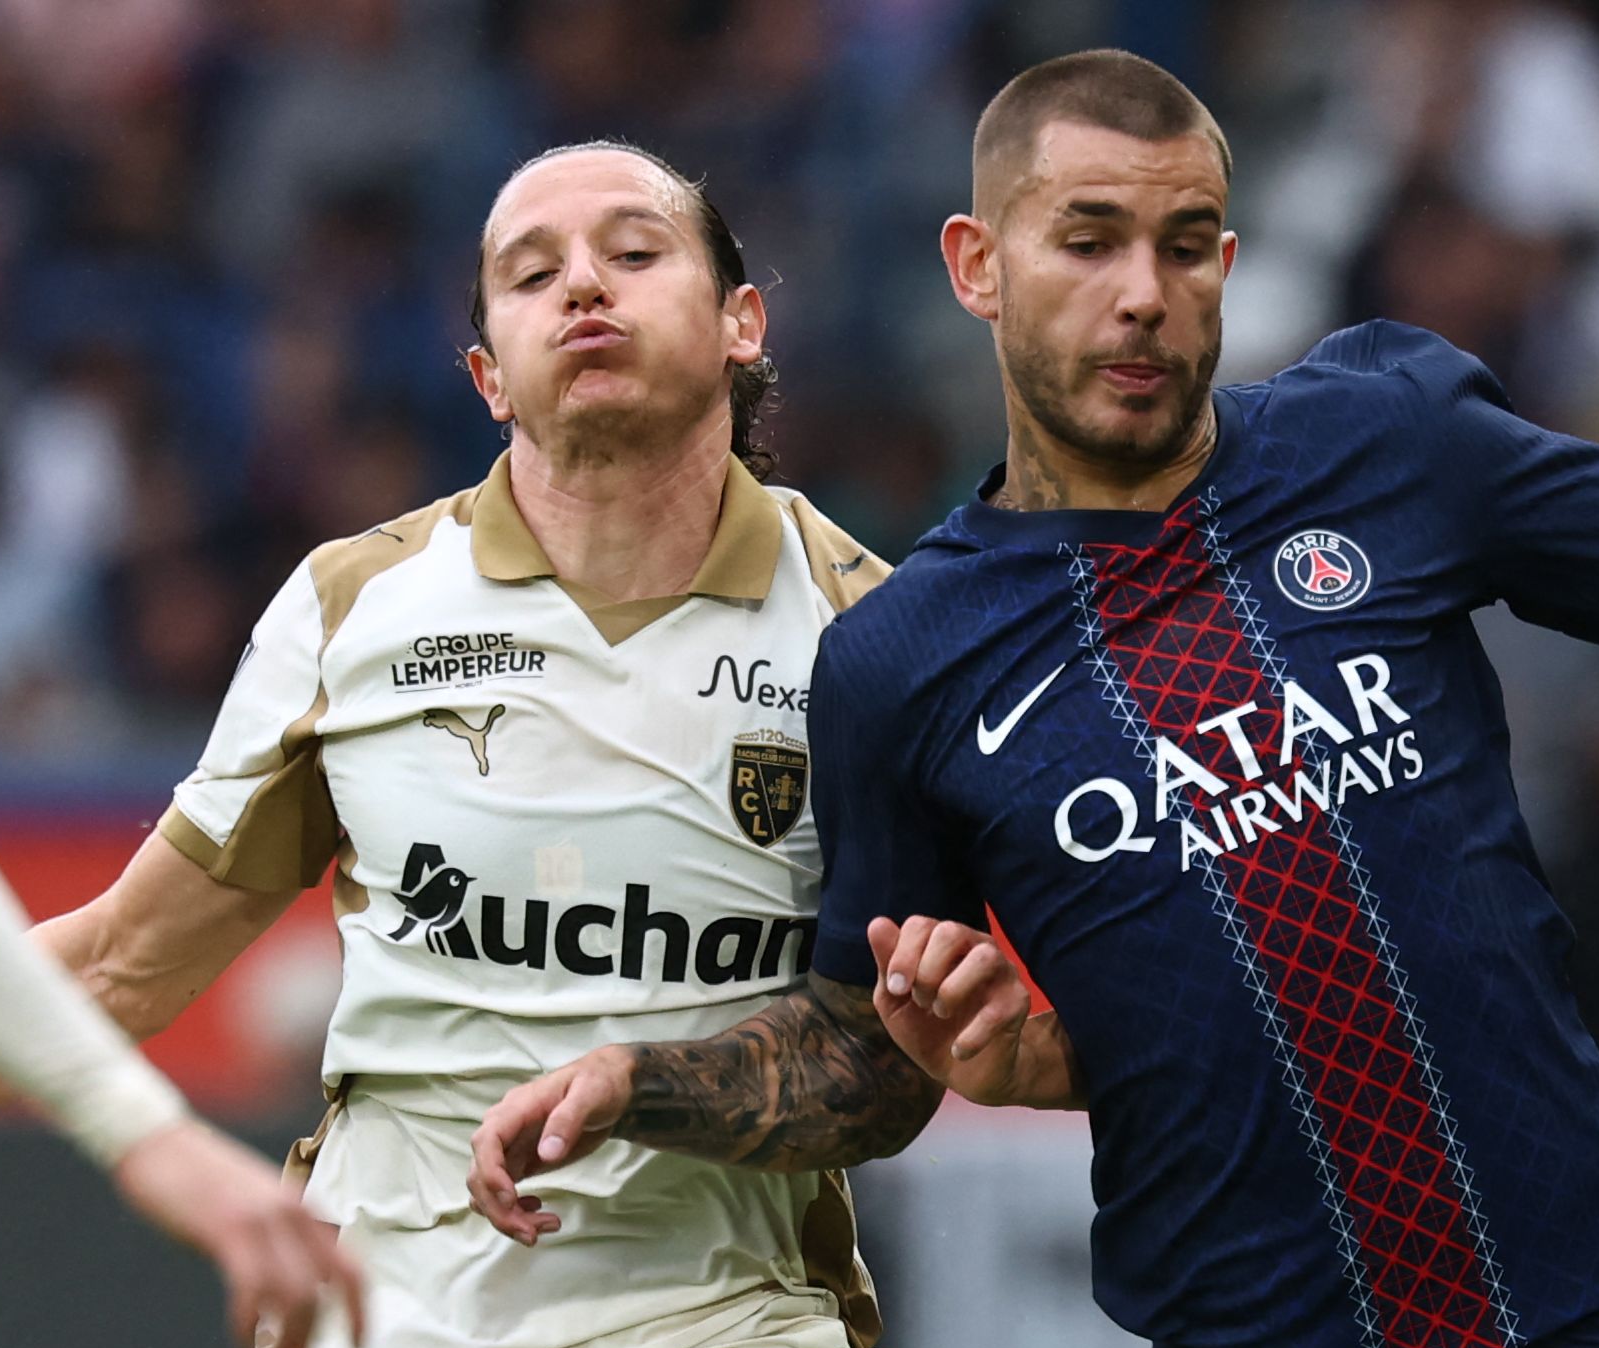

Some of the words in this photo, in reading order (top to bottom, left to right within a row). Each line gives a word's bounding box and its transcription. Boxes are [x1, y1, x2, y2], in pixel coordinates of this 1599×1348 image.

[1282, 535, 1340, 562] PARIS
[413, 633, 518, 659] GROUPE
[391, 650, 546, 686] LEMPEREUR
[759, 729, 785, 744] 120
[1054, 653, 1411, 862] QATAR
[1180, 730, 1424, 872] AIRWAYS
[387, 842, 818, 986] Auchan
